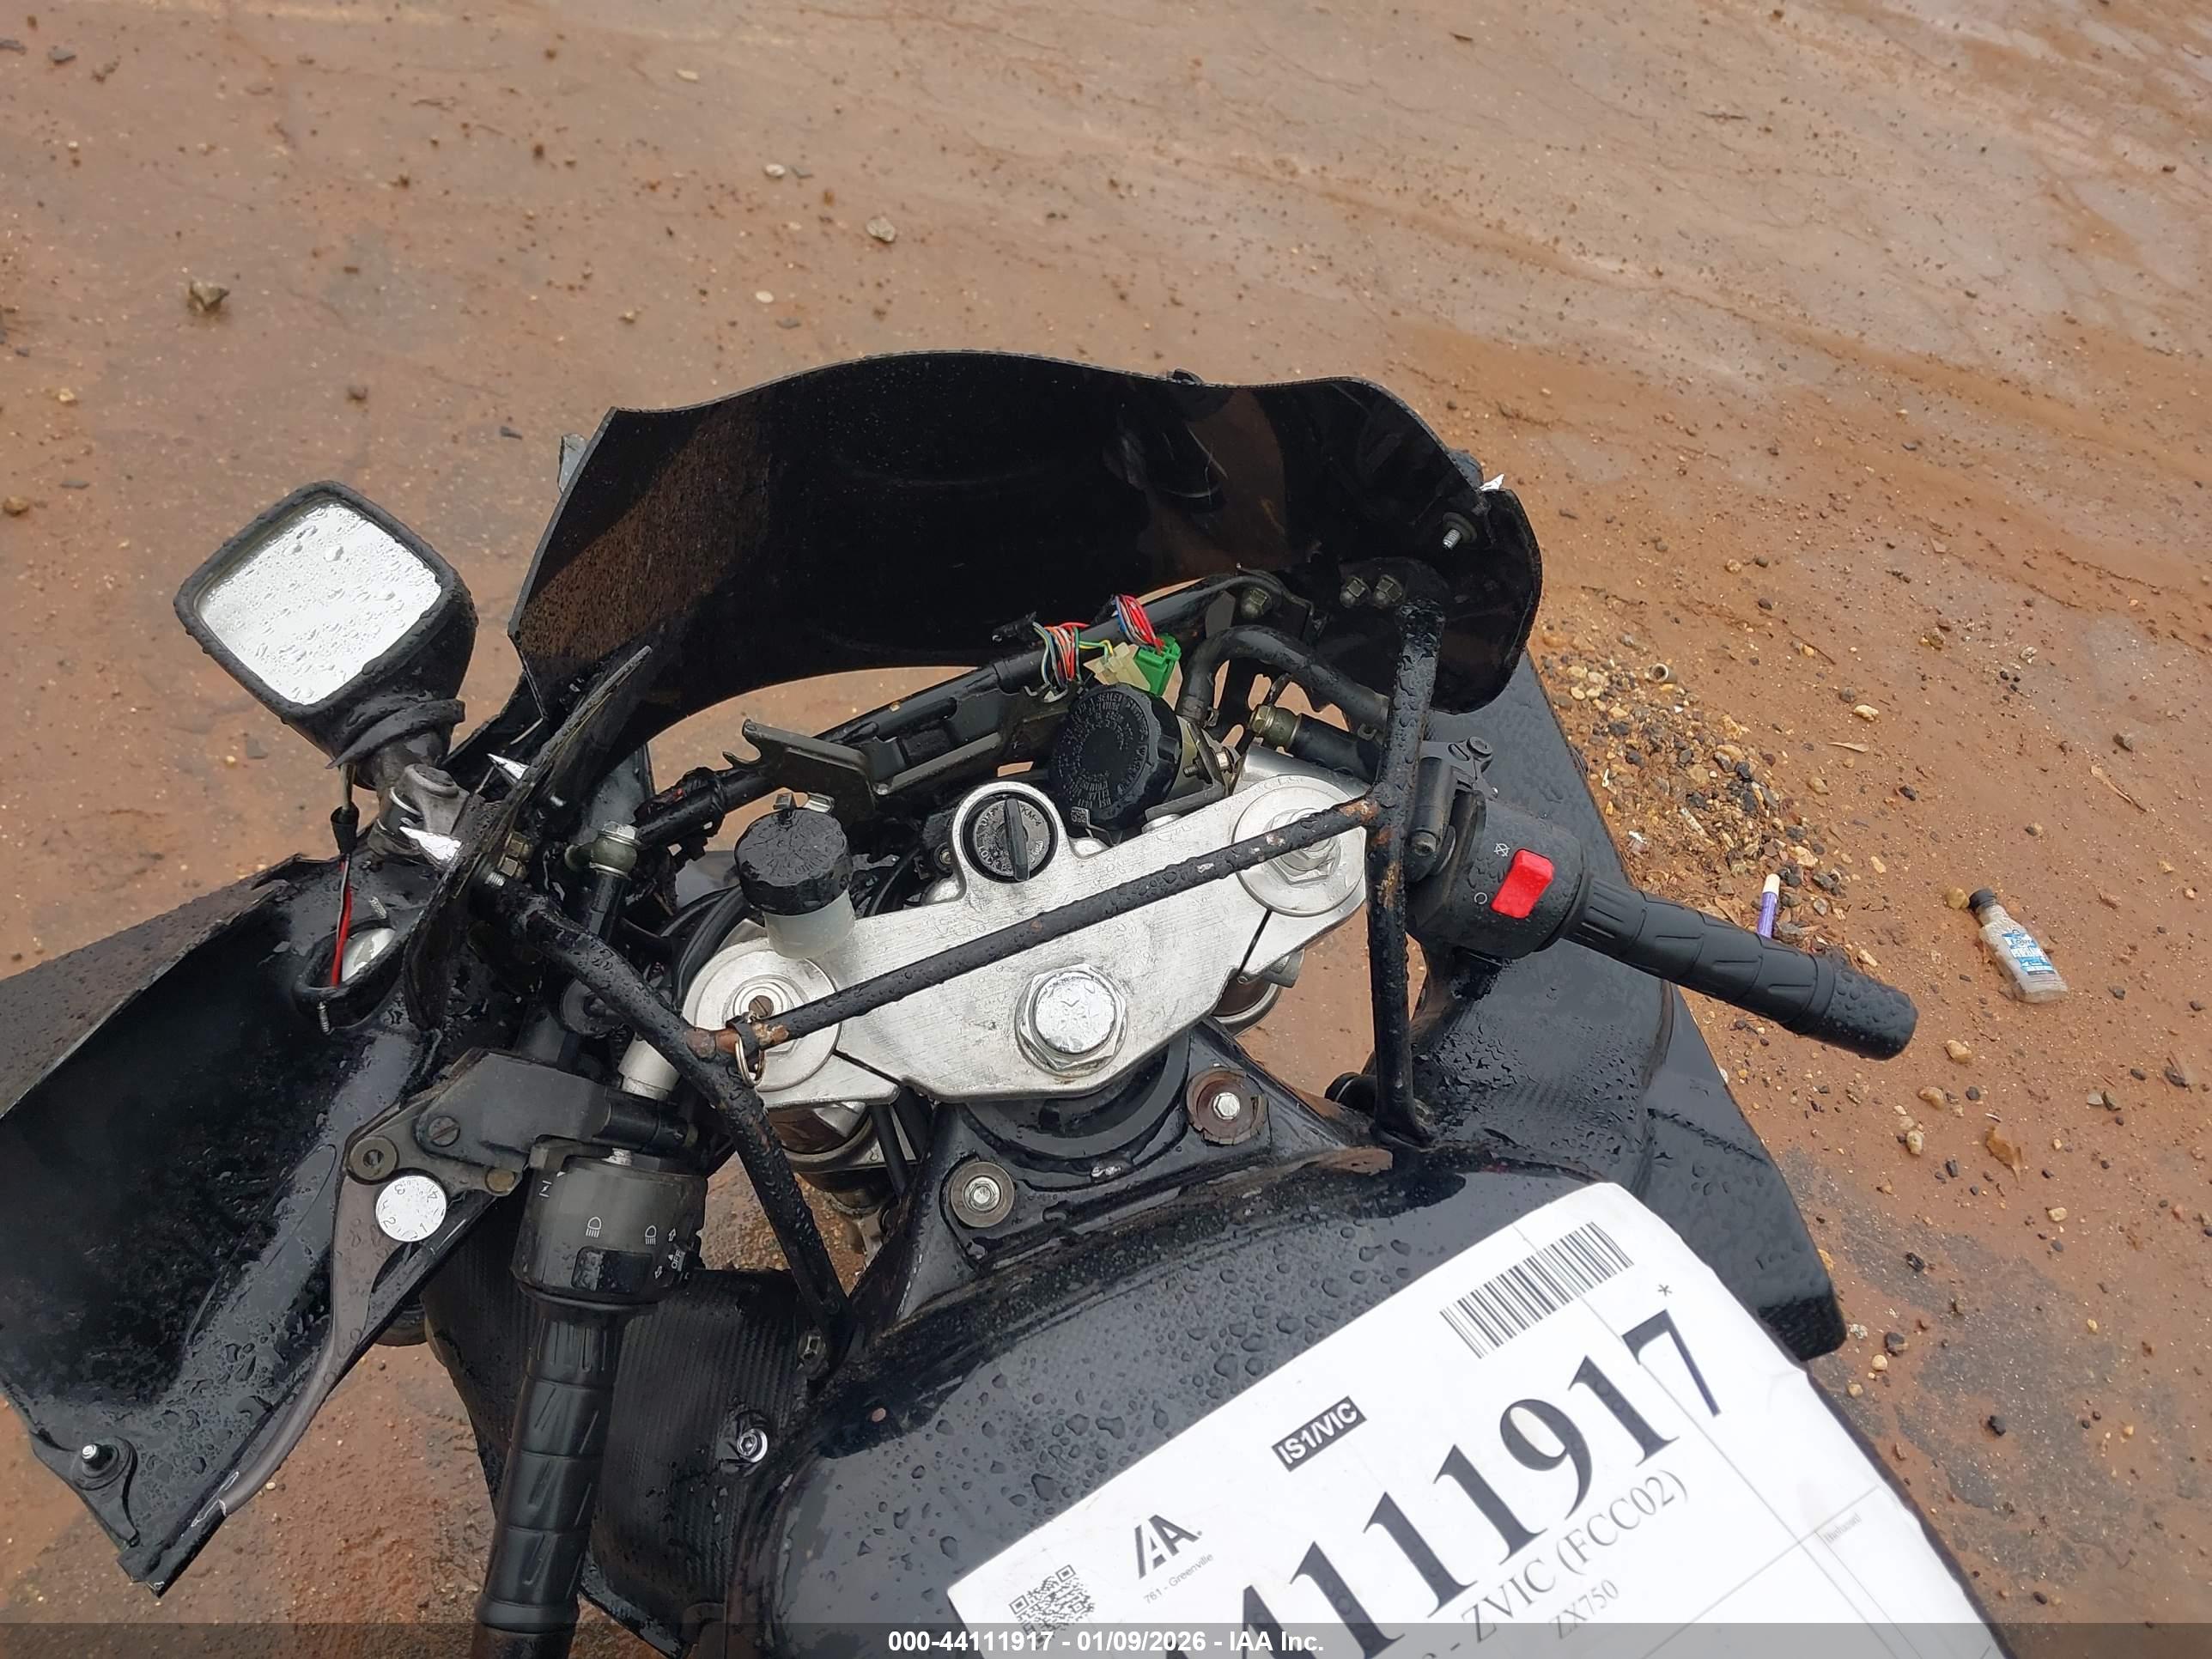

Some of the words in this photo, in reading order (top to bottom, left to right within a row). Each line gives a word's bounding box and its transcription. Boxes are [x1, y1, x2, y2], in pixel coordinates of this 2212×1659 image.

[1277, 1401, 1358, 1465] IS1/VIC
[1143, 1588, 1163, 1604] 761
[1168, 1553, 1214, 1587] Greenville
[1461, 1558, 1556, 1644] ZVIC
[1556, 1469, 1688, 1577] (FCC02)
[1548, 1579, 1620, 1640] ZX750
